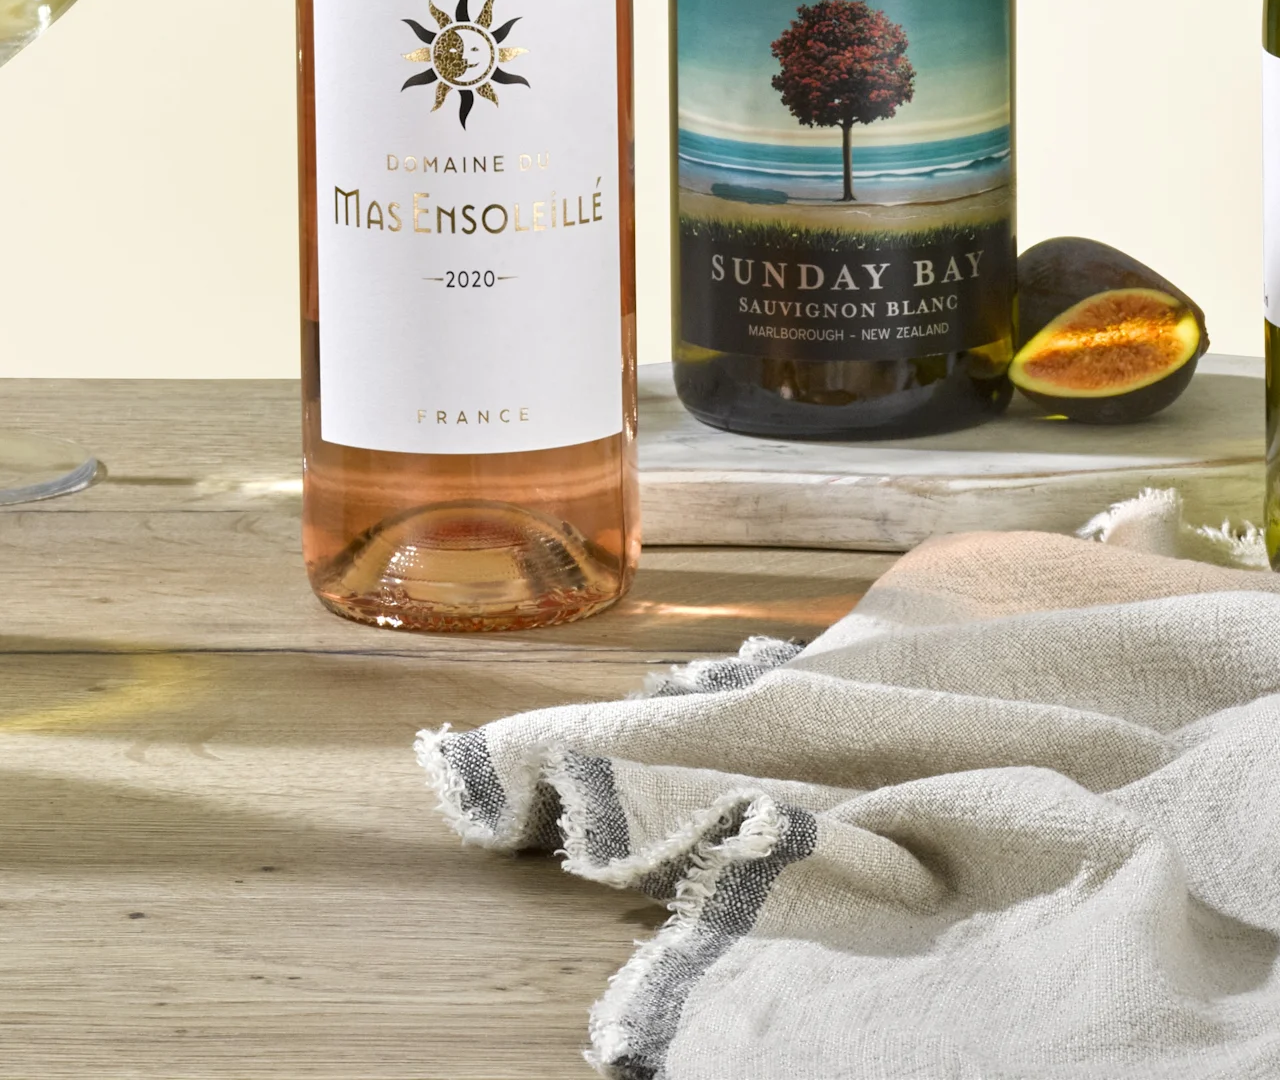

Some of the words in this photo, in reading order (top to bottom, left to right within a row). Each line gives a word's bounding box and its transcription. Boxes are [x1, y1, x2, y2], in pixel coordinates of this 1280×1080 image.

[386, 153, 505, 174] DOMAINE
[519, 150, 551, 171] DU
[445, 270, 496, 289] 2020
[710, 254, 891, 291] SUNDAY
[913, 250, 985, 287] BAY
[738, 297, 877, 319] SAUVIGNON
[886, 294, 959, 317] BLANC
[748, 324, 845, 342] MARLBOROUGH
[861, 327, 891, 341] NEW
[896, 322, 950, 340] ZEALAND
[417, 407, 530, 425] FRANCE
